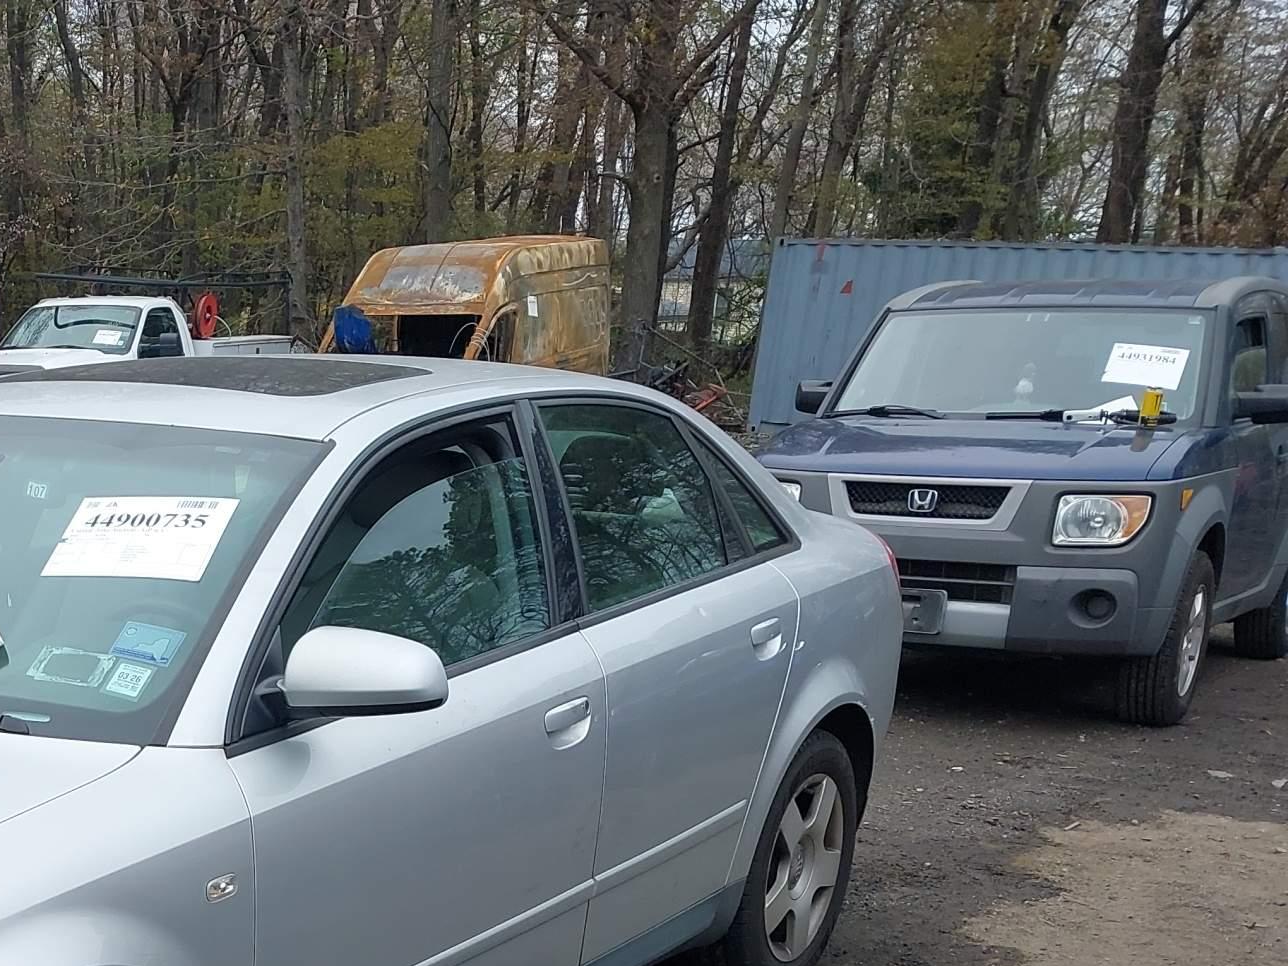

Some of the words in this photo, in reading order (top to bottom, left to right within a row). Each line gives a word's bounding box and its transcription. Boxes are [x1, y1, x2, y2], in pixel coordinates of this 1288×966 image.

[1118, 352, 1176, 365] 44931984
[84, 513, 210, 528] 44900735
[117, 671, 130, 681] 03
[130, 674, 143, 684] 26
